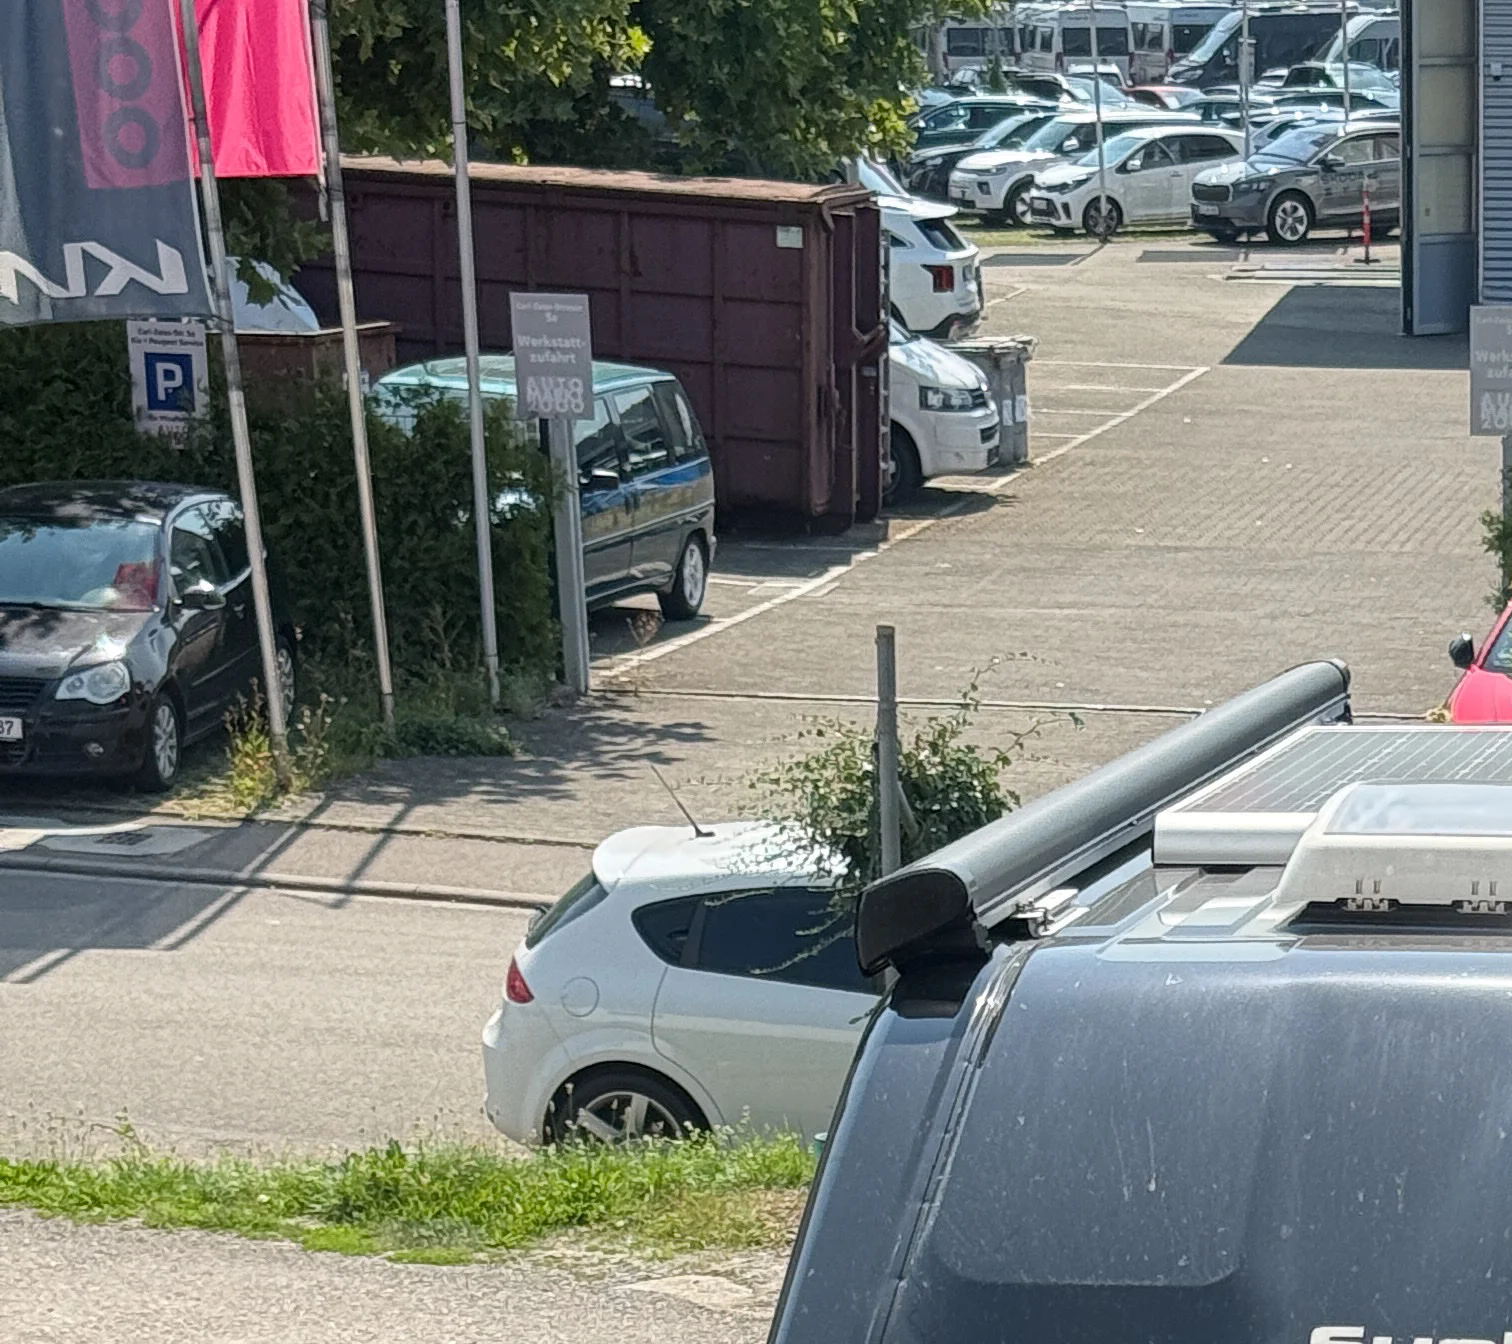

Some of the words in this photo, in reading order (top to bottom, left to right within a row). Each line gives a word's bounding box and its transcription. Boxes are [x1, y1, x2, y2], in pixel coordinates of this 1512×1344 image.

[518, 335, 587, 348] Werkstatt-
[530, 349, 576, 363] zufahrt
[155, 362, 184, 401] P
